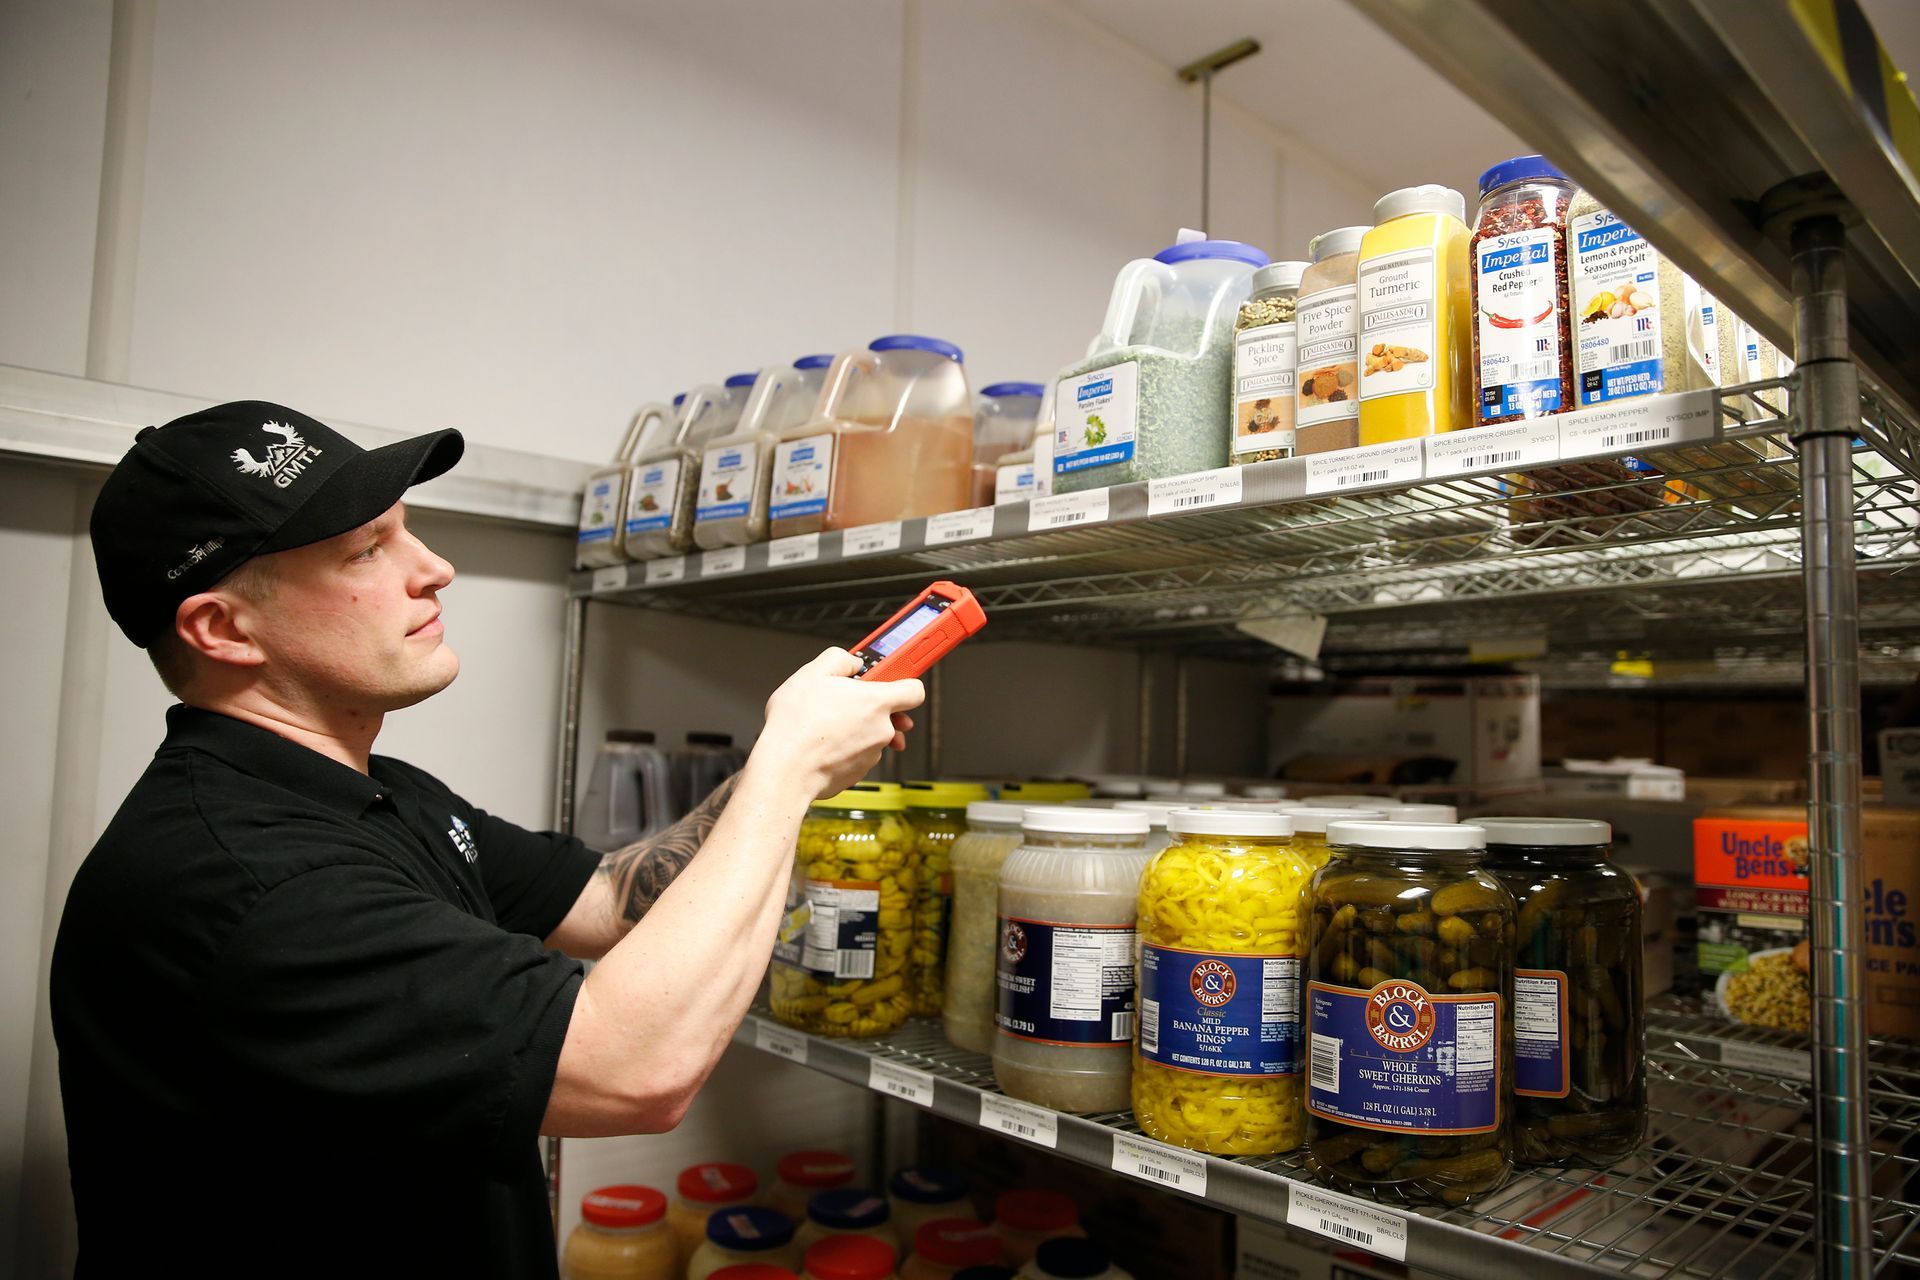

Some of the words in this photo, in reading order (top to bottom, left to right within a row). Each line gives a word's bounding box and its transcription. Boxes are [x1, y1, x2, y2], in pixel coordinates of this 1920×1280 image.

[1498, 235, 1529, 248] Sysco
[1581, 228, 1637, 248] Imperi
[1484, 245, 1547, 269] Imperial
[1581, 250, 1609, 265] Lemon
[1611, 248, 1617, 257] &
[1584, 259, 1627, 275] Seasoning
[1629, 253, 1645, 264] Salt
[1379, 270, 1409, 285] Ground
[1499, 269, 1531, 281] Crushed
[1369, 280, 1421, 299] Turmeric
[1492, 282, 1507, 294] Red
[1303, 312, 1322, 324] Five
[1324, 304, 1352, 319] Spice
[1367, 305, 1424, 328] D'ALLESANDRO
[1309, 320, 1344, 335] Powder
[1248, 343, 1285, 356] Pickling
[1303, 339, 1354, 360] D'ALLESANDRO
[1580, 337, 1610, 351] 9806480
[1253, 354, 1278, 367] Spice
[1482, 355, 1510, 367] 9806423
[1638, 372, 1650, 382] NETO
[1078, 379, 1112, 399] Imperial
[1078, 401, 1094, 410] Parsley
[1096, 397, 1111, 406] Flakes
[1568, 416, 1590, 426] SPICE
[1591, 412, 1617, 423] LEMON
[1618, 407, 1649, 418] PEPPER
[1666, 412, 1694, 423] SYSCO
[1433, 439, 1451, 448] SPICE
[1452, 436, 1467, 446] RED
[1468, 433, 1495, 443] PEPPER
[1495, 427, 1528, 438] CRUSHED
[1531, 435, 1555, 444] SYSCO
[1312, 458, 1328, 466] SPICE
[1328, 455, 1356, 464] TURMERIC
[1356, 450, 1380, 460] GROUND
[1381, 447, 1398, 456] (DROP
[1399, 445, 1415, 453] SHIP)
[1394, 456, 1418, 465] D'ALLAS
[1450, 449, 1463, 458] pack
[274, 445, 322, 489] GMT1
[1722, 832, 1783, 859] Uncle
[1735, 856, 1788, 880] Ben's
[1195, 962, 1231, 980] BLOCK
[1205, 974, 1220, 991] &
[1194, 987, 1231, 1004] BARREL
[1372, 986, 1428, 1012] BLOCK
[1197, 1006, 1227, 1018] Classic
[1389, 1005, 1413, 1028] &
[1173, 1020, 1213, 1034] BANANA
[1215, 1026, 1249, 1037] PEPPER
[1202, 1017, 1221, 1025] MILD
[1196, 1033, 1226, 1045] RINGS
[1372, 1024, 1428, 1049] BARREL
[1199, 1044, 1223, 1053] 5/16KK
[1172, 1053, 1180, 1062] NET
[1180, 1055, 1201, 1066] CONTENTS
[1201, 1058, 1209, 1067] 128
[1210, 1059, 1215, 1067] FL
[1216, 1059, 1223, 1068] OZ
[1228, 1061, 1239, 1069] GAL)
[1382, 1061, 1418, 1073] WHOLE
[1358, 1069, 1388, 1082] SWEET
[1391, 1073, 1441, 1085] GHERKINS
[1371, 1083, 1391, 1092] Approx.
[1413, 1086, 1430, 1094] Count
[1363, 1101, 1373, 1111] 128
[1373, 1103, 1382, 1112] FL
[1382, 1104, 1392, 1113] OZ
[1393, 1105, 1398, 1115] (1
[1400, 1106, 1417, 1116] GAL)
[1419, 1107, 1431, 1116] 3.78
[1432, 1108, 1437, 1116] L
[1296, 1190, 1314, 1201] PICKLE
[1315, 1196, 1339, 1208] GHERKIN
[1339, 1203, 1358, 1215] SWEET
[1360, 1210, 1380, 1222] 171-184
[1381, 1216, 1401, 1228] COUNT
[1296, 1200, 1304, 1208] EA
[1310, 1205, 1322, 1214] pack
[1332, 1211, 1342, 1219] GAL
[1377, 1226, 1405, 1240] BBRLCLS
